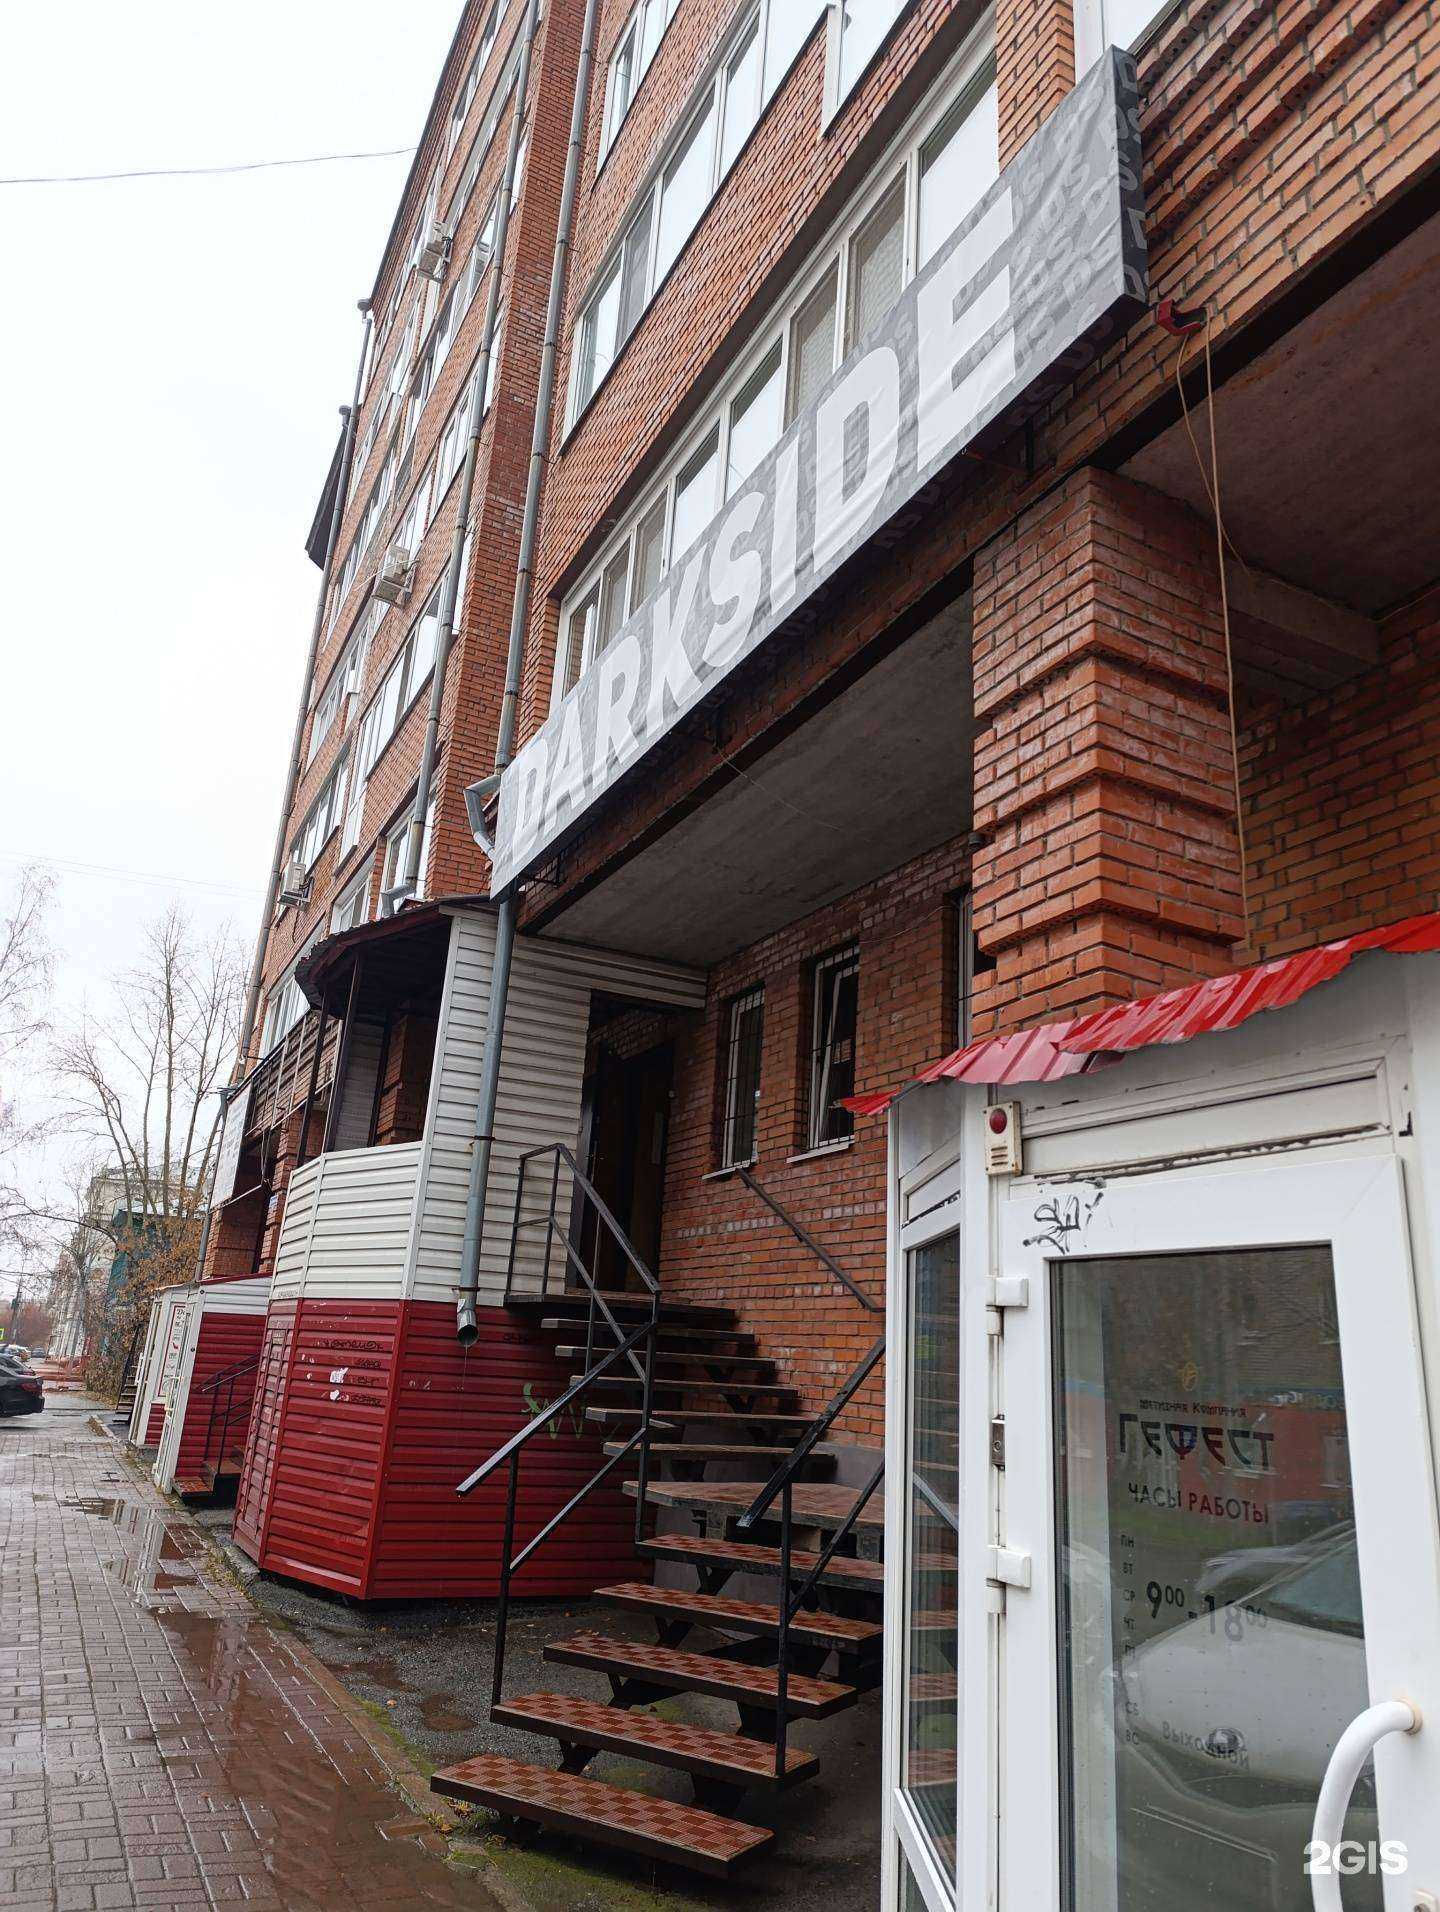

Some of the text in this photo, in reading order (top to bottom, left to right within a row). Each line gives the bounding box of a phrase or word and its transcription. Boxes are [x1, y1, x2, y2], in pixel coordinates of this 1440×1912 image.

[512, 190, 1017, 847] DARKSIDE
[1119, 1413, 1274, 1472] ГЕФЕСТ
[1128, 1482, 1269, 1524] ЧАСЫ РАБОТЫ
